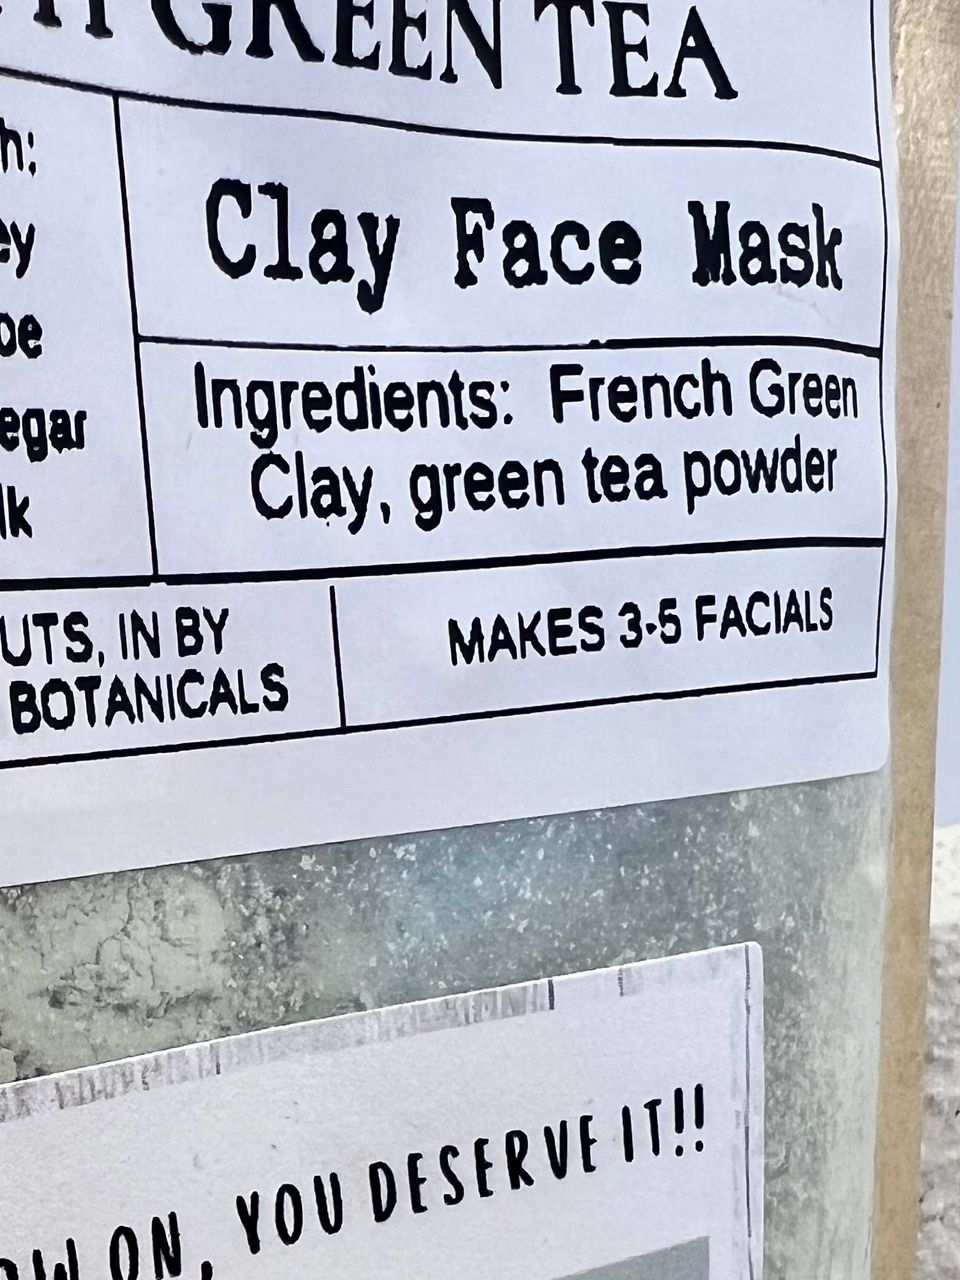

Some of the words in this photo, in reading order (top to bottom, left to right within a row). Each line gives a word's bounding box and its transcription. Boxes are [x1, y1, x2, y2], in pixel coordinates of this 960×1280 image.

[151, 0, 502, 89] GREEN
[534, 0, 738, 100] TEA
[206, 178, 400, 315] Clay
[451, 197, 641, 289] Face
[688, 201, 842, 291] Mask
[195, 362, 513, 449] Ingredients:
[550, 358, 732, 423] French
[750, 358, 857, 419] Green
[251, 450, 390, 535] Clay,
[410, 459, 564, 531] green
[581, 447, 668, 503] tea
[684, 434, 837, 515] powder
[119, 610, 160, 660] IN
[176, 607, 229, 657] BY
[448, 606, 605, 666] MAKES
[618, 598, 681, 648] 3-5
[696, 587, 832, 641] FACIALS
[10, 663, 288, 734] BOTANICALS
[236, 1172, 342, 1254] YOU
[369, 1115, 597, 1222] DESERVE
[622, 1084, 704, 1162] IT!!
